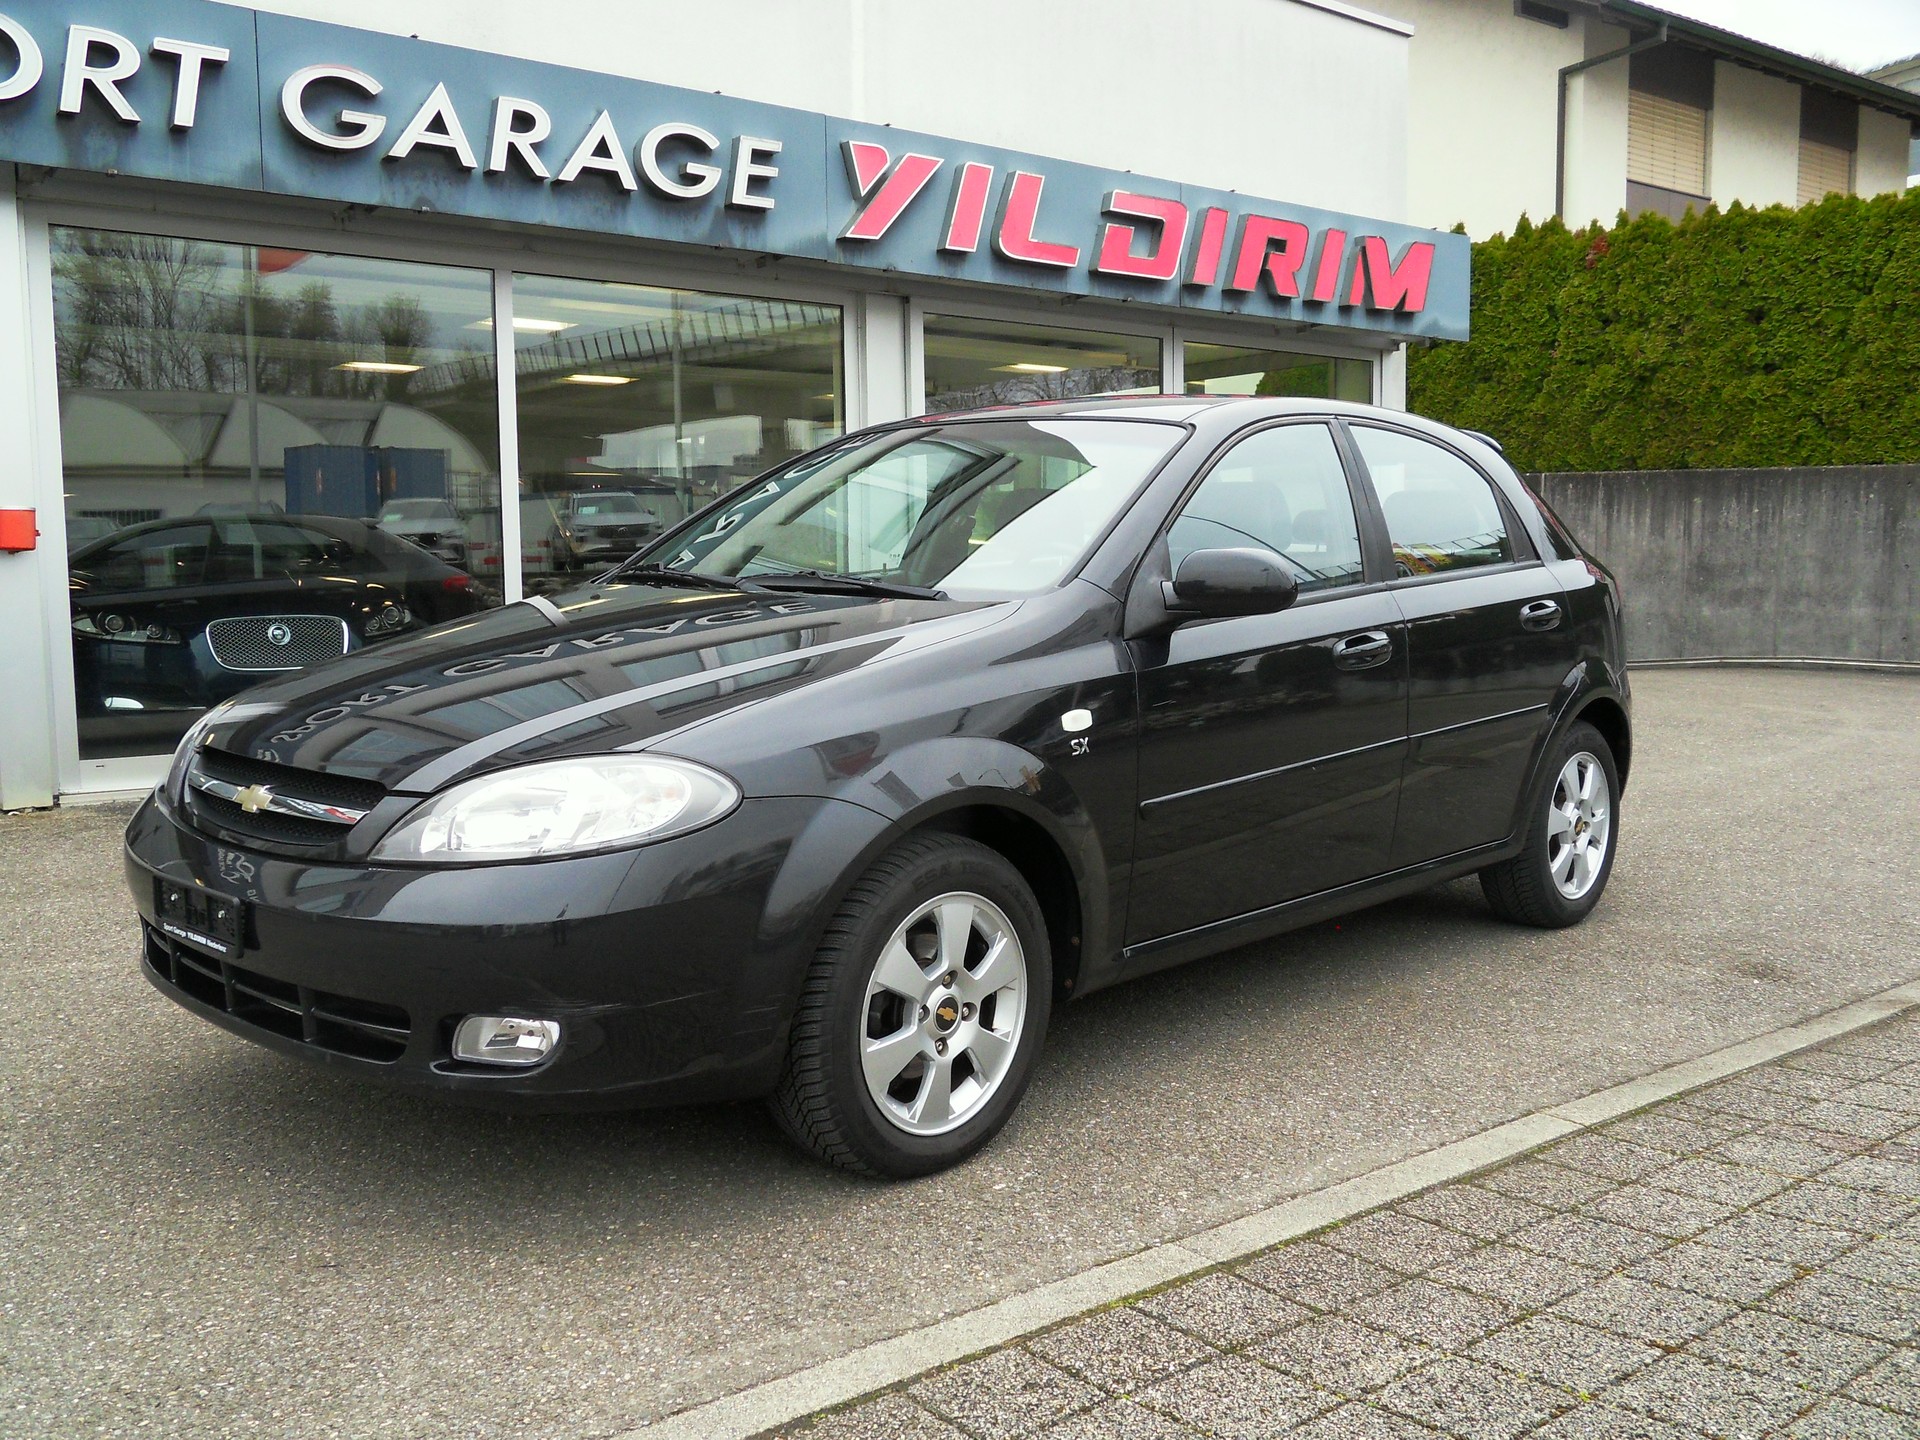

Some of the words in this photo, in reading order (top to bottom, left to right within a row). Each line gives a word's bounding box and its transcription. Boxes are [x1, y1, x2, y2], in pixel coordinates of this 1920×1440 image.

[279, 63, 783, 211] GARAGE
[837, 138, 1435, 313] YILDIRIM
[1070, 736, 1090, 756] SX
